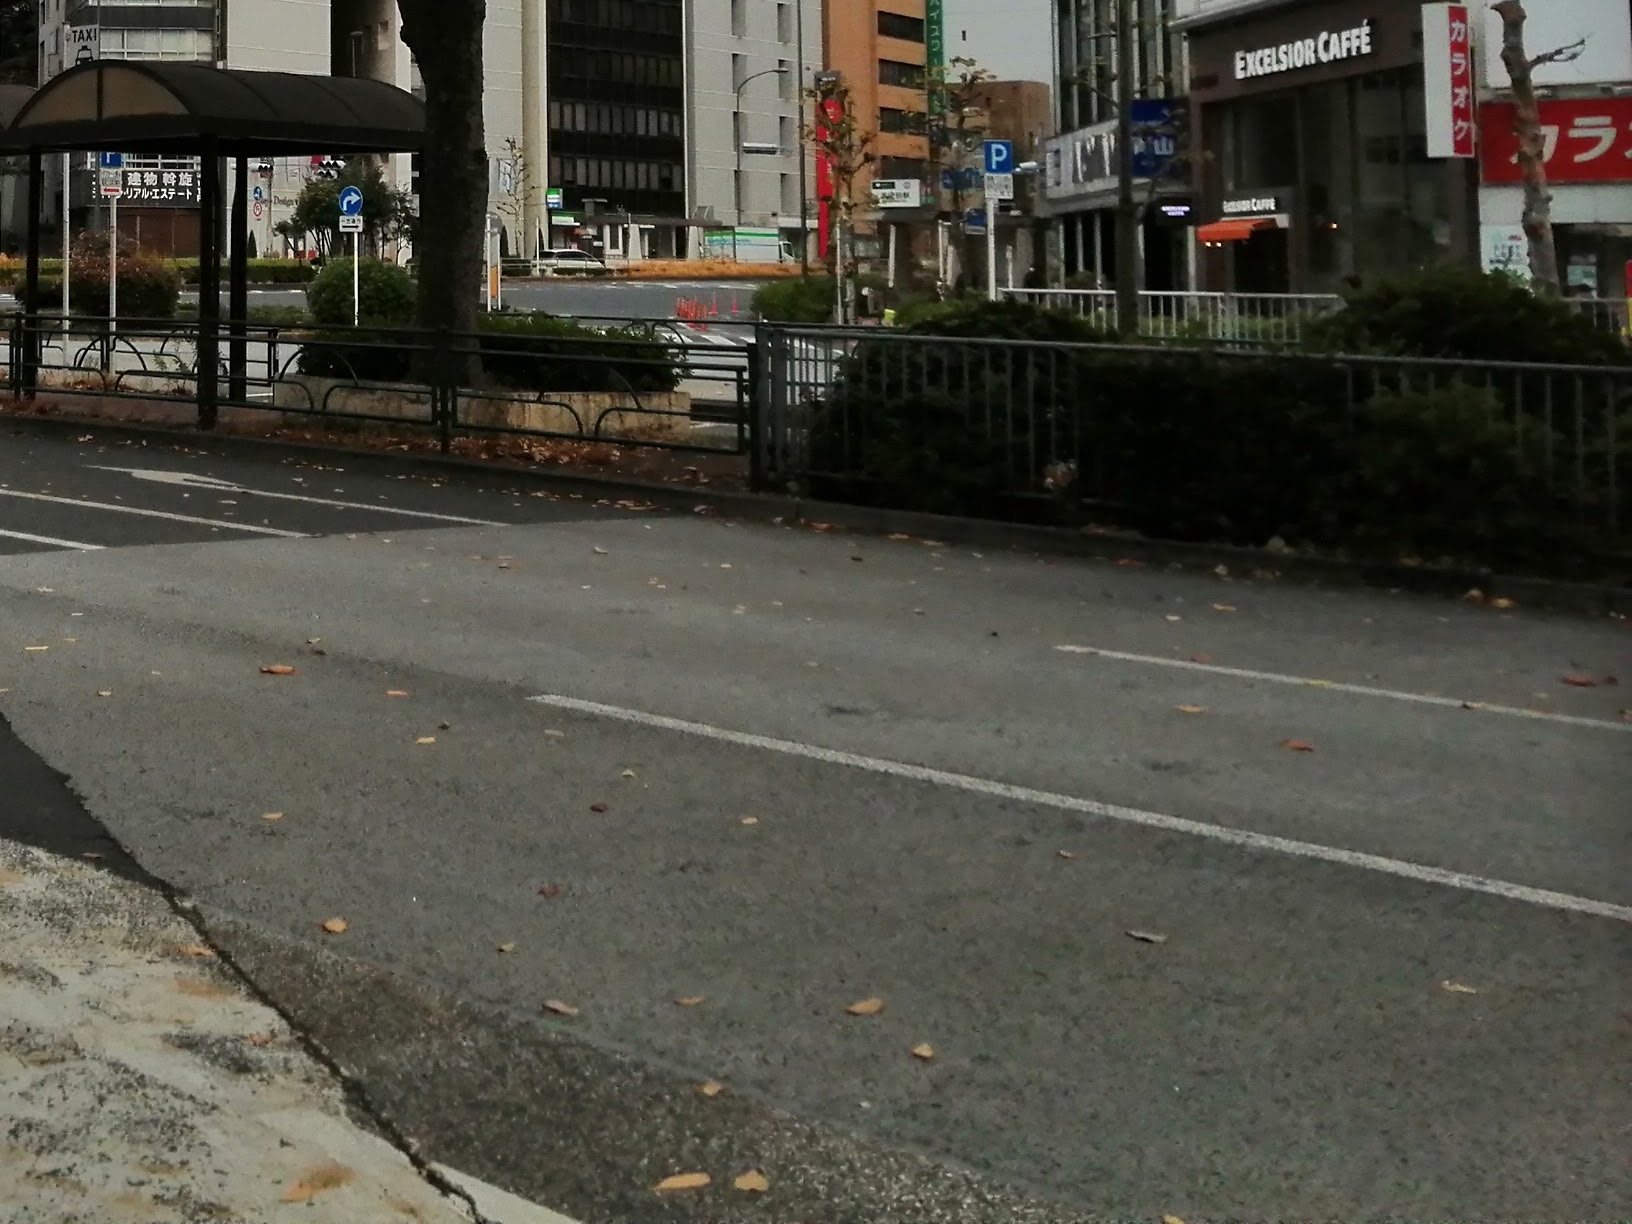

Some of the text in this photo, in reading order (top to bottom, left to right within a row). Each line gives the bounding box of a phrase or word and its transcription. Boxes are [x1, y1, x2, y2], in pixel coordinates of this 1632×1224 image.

[72, 28, 97, 44] TAXI
[1235, 37, 1317, 80] EXCELSIOR
[1449, 21, 1472, 143] カラオケ
[990, 142, 1007, 170] P
